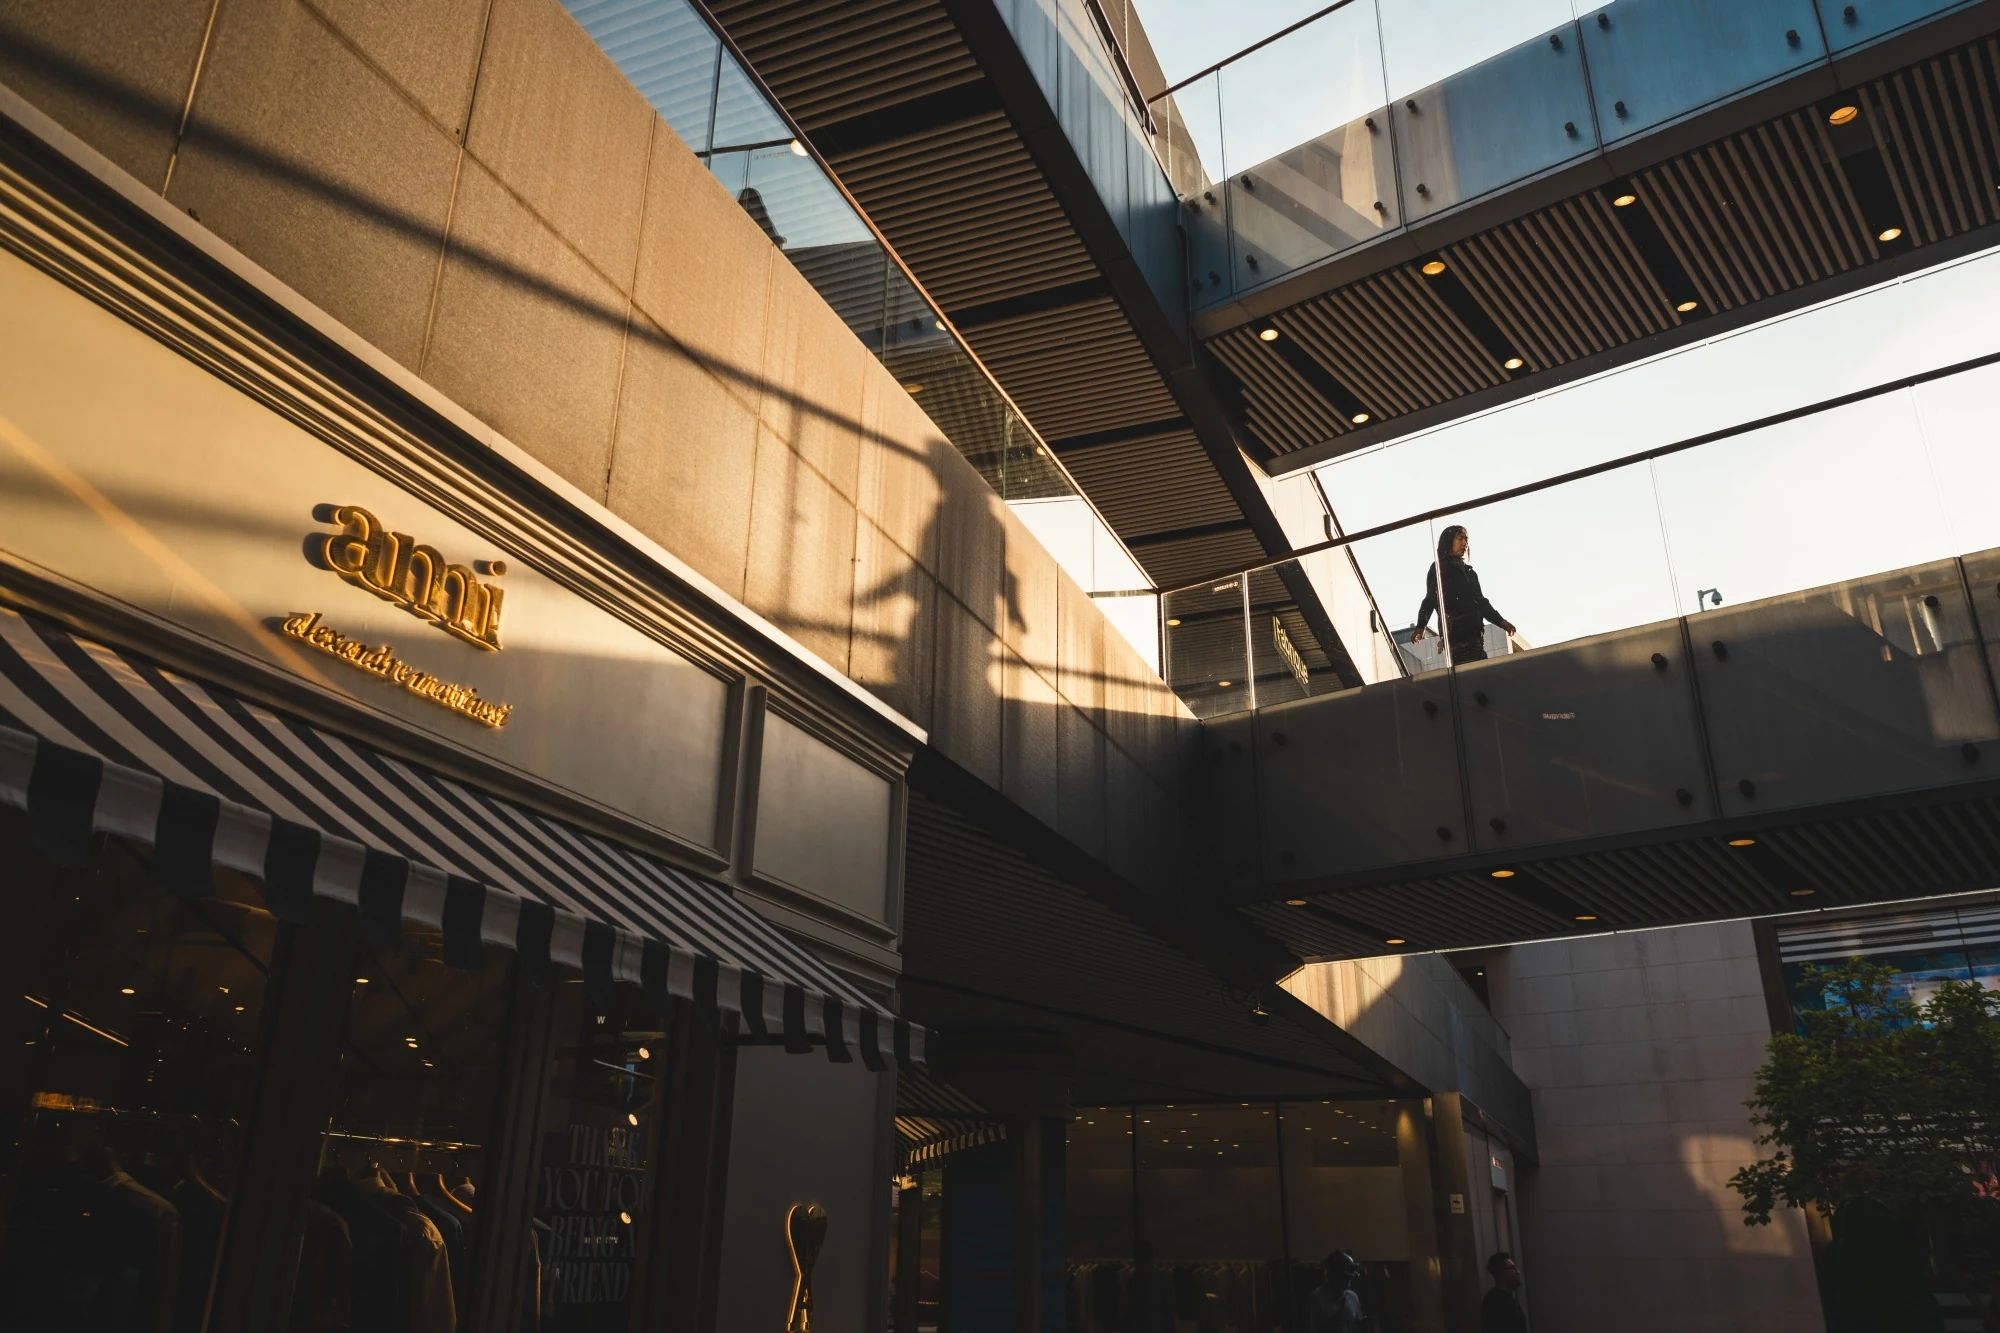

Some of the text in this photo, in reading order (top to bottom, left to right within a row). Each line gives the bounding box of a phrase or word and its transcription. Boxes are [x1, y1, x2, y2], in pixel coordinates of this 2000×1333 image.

[325, 505, 507, 652] ami
[282, 612, 414, 684] alexandre
[544, 1166, 600, 1212] YOU
[547, 1215, 617, 1259] BEING
[548, 1261, 631, 1304] FRIEND
